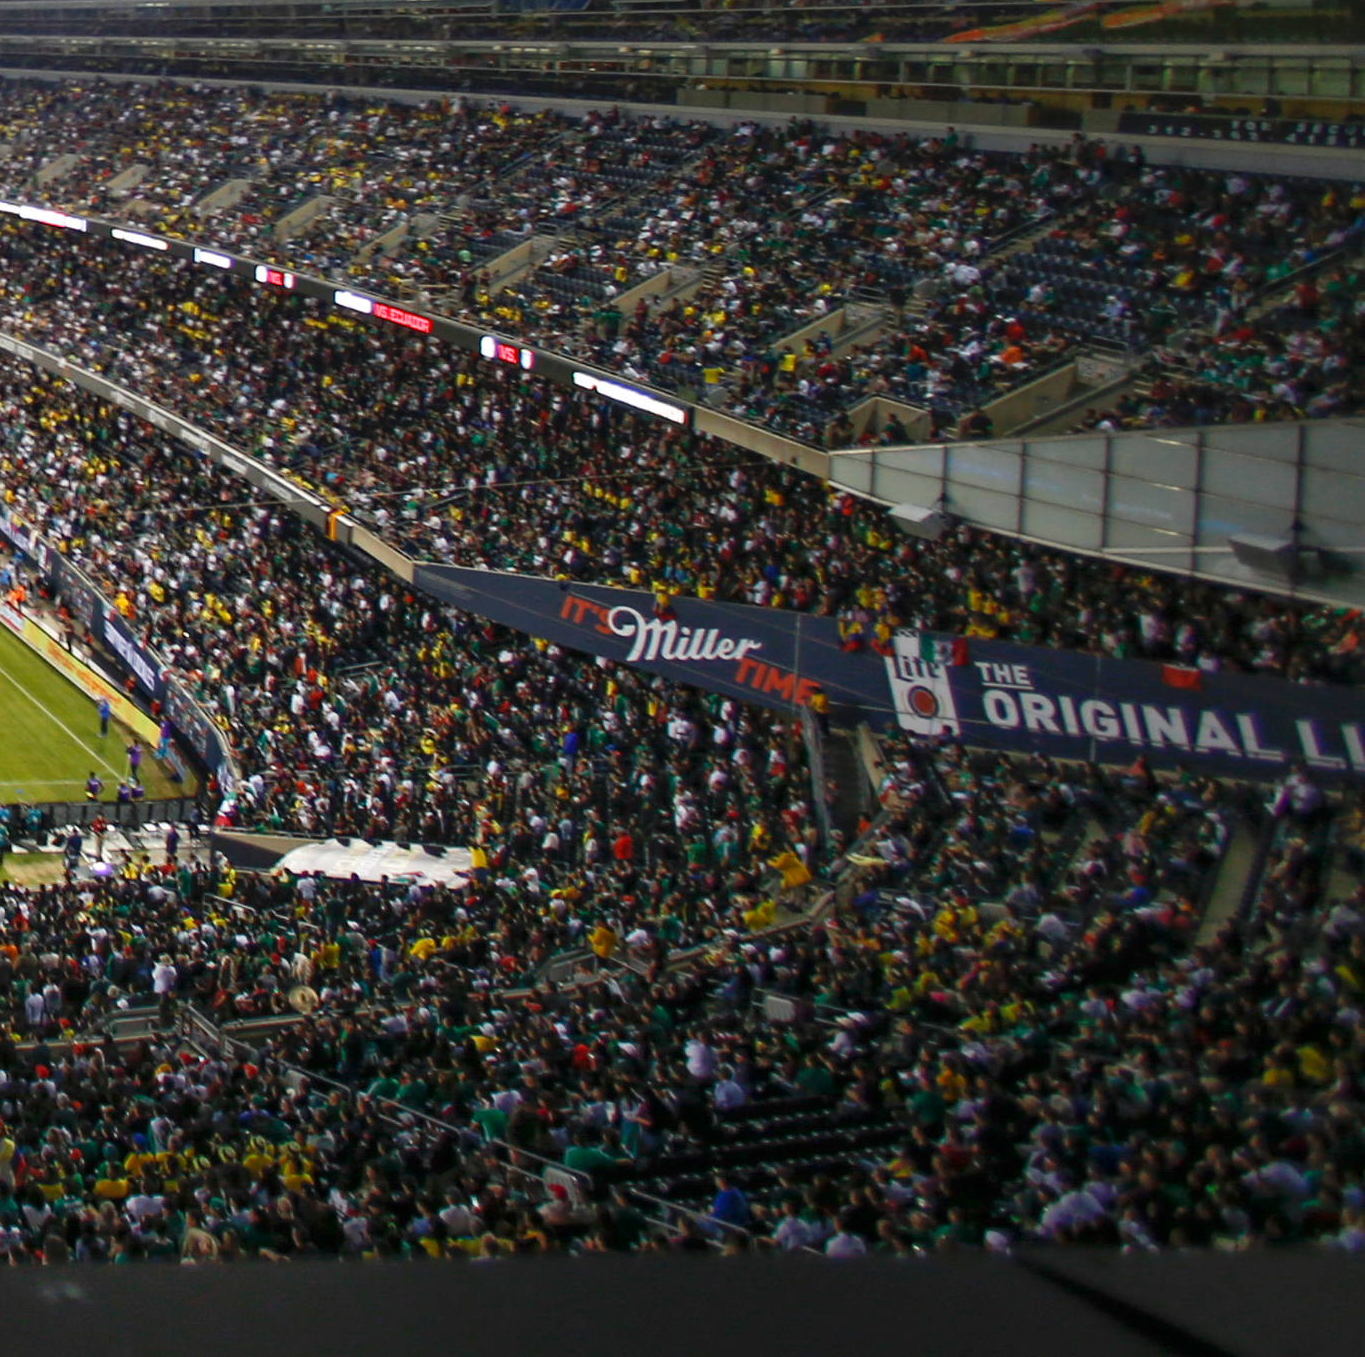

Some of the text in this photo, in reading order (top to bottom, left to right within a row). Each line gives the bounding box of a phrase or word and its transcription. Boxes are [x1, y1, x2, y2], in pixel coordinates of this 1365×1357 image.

[560, 595, 825, 707] IT'S Miller TIME
[974, 660, 1030, 686] THE
[982, 690, 1285, 762] ORIGINAL
